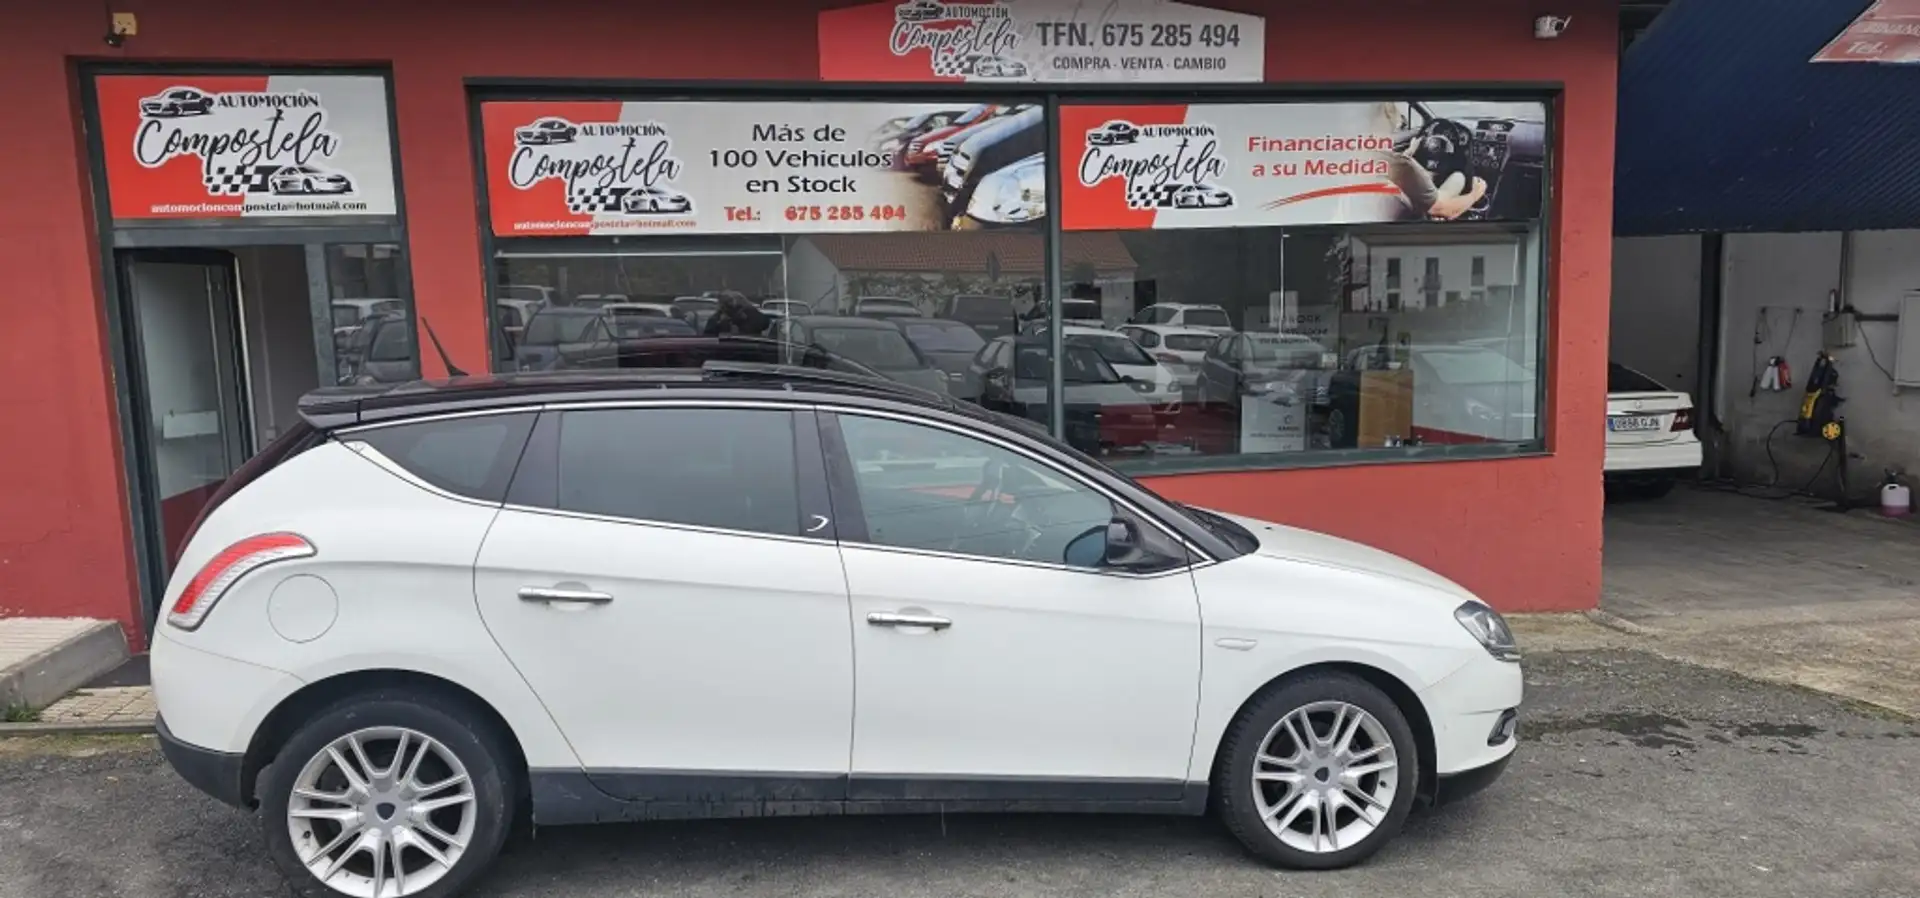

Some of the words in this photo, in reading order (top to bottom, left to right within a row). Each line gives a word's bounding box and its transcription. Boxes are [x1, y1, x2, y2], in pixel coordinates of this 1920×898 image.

[892, 17, 1020, 62] Compostela
[1036, 22, 1094, 47] TFN.
[1102, 23, 1144, 47] 675
[1150, 23, 1192, 47] 285
[1199, 24, 1240, 47] 494
[1053, 56, 1111, 70] COMPRA
[1121, 56, 1163, 70] VENTA
[1173, 56, 1227, 70] CAMBIO
[217, 91, 319, 108] AUTOMOCIÓN
[579, 122, 666, 137] AUTOMOCIÓN
[752, 124, 805, 142] Más
[813, 124, 846, 142] de
[1141, 124, 1215, 137] AUTOMOCIÓN
[136, 109, 338, 175] Compostela
[1248, 133, 1393, 152] Financiación
[511, 137, 680, 197] Compostela
[710, 149, 757, 168] 100
[1081, 137, 1226, 194] Compostela
[1252, 164, 1265, 177] a
[1272, 163, 1297, 176] su
[1304, 159, 1388, 175] Medida
[746, 178, 779, 193] en
[787, 175, 857, 193] Stock
[784, 205, 822, 221] 675
[827, 205, 864, 221] 285
[869, 205, 907, 221] 494
